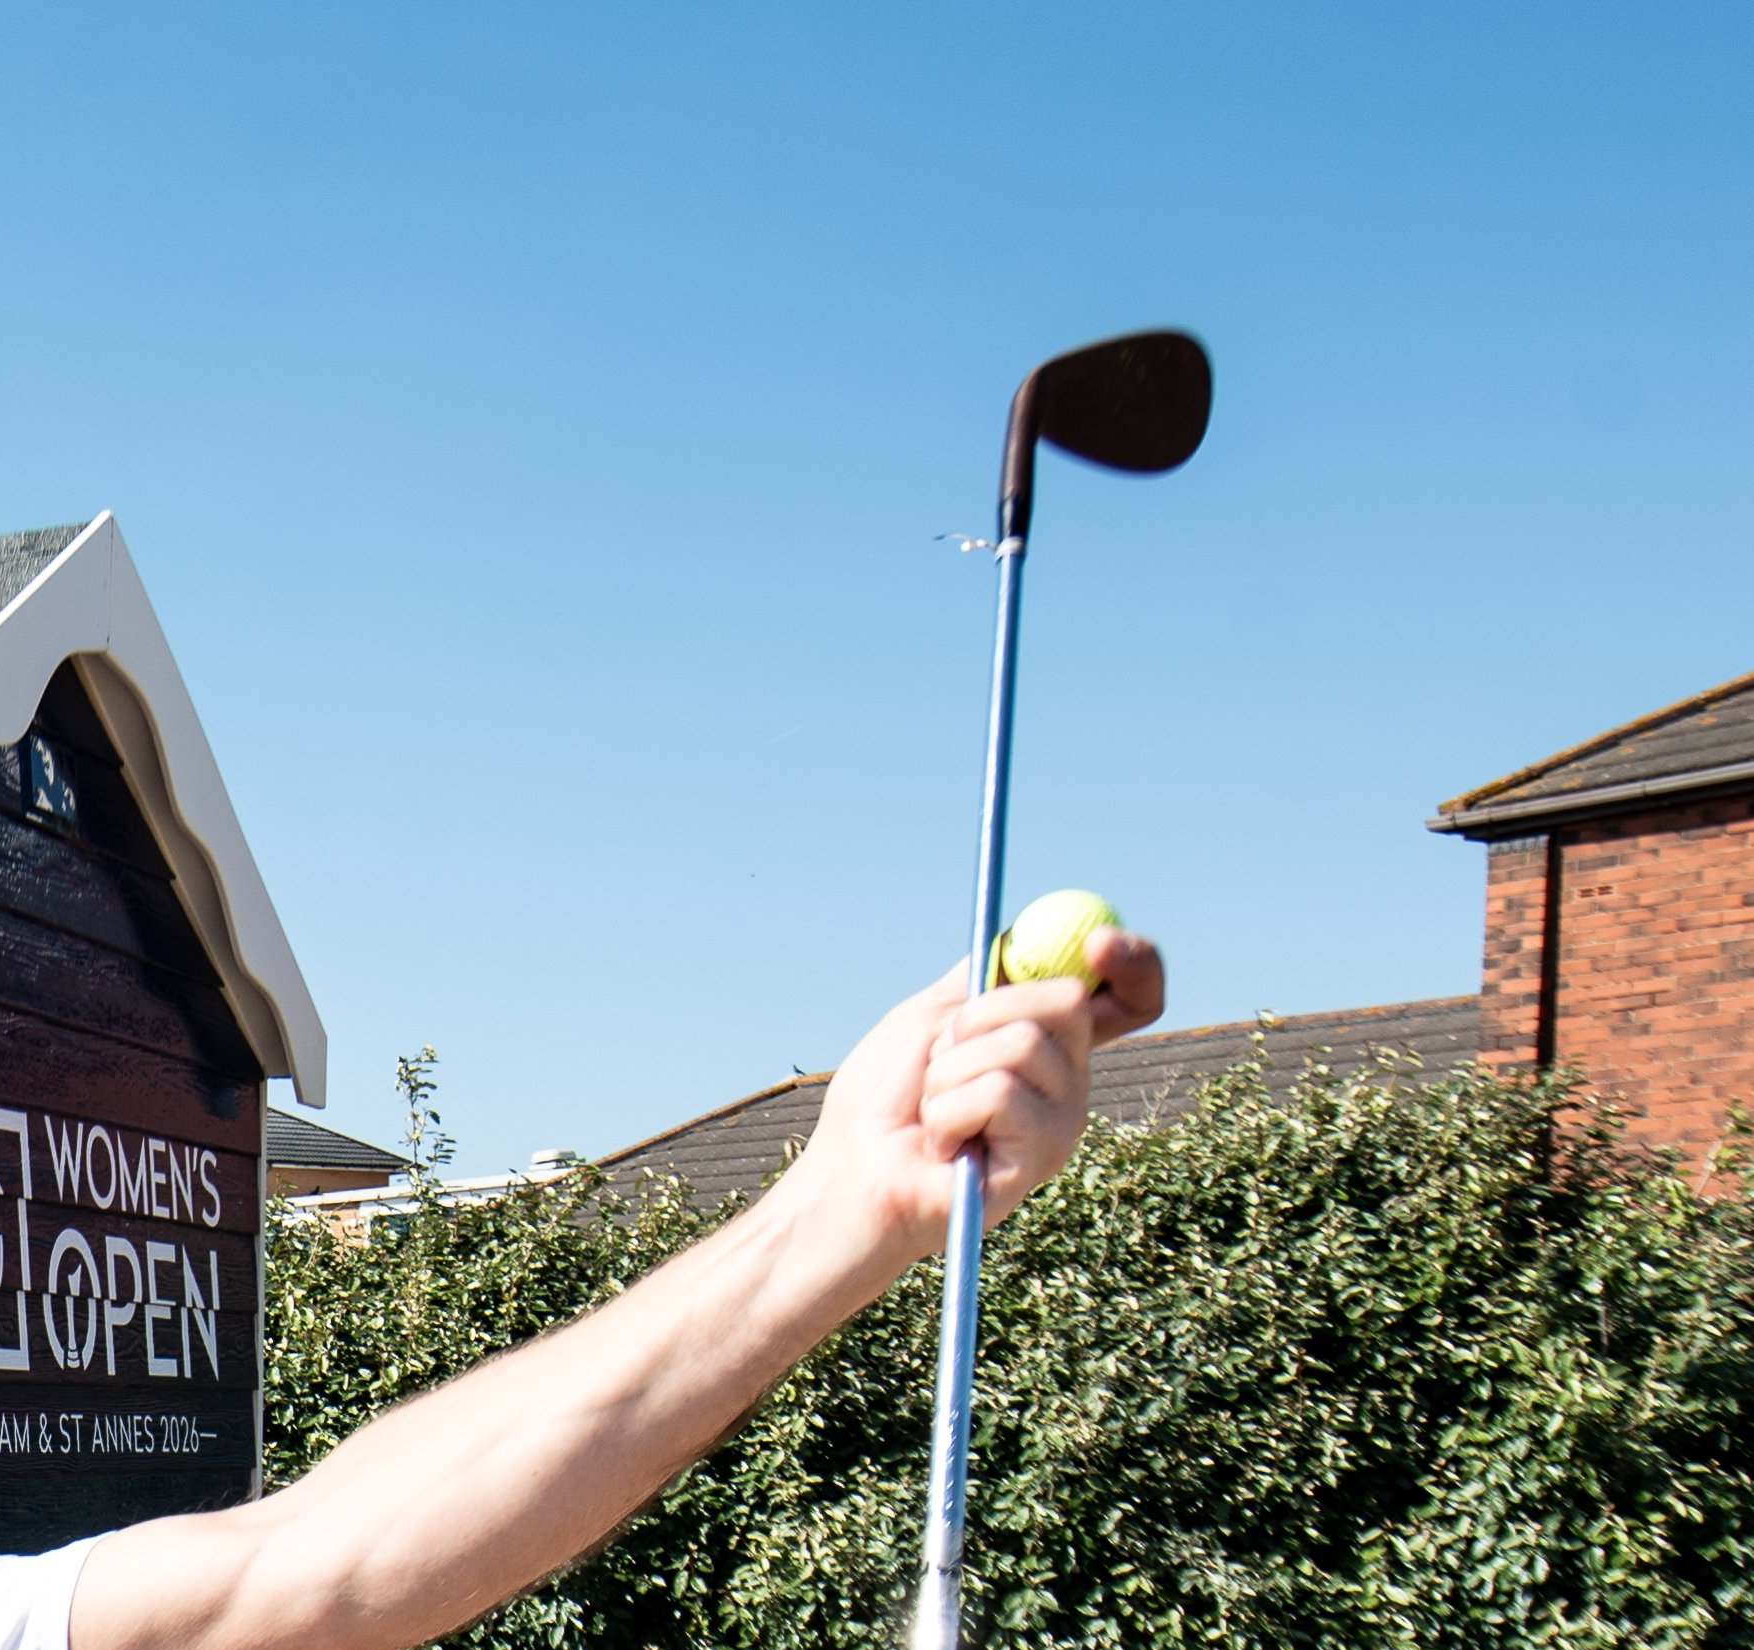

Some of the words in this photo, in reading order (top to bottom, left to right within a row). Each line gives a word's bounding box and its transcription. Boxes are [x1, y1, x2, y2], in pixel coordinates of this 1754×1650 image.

[44, 1114, 221, 1228] WOMEN'S
[42, 1227, 220, 1382] OPEN
[38, 1412, 53, 1454] &
[59, 1413, 83, 1454] ST
[92, 1414, 155, 1454] ANNES
[160, 1414, 200, 1454] 2026
